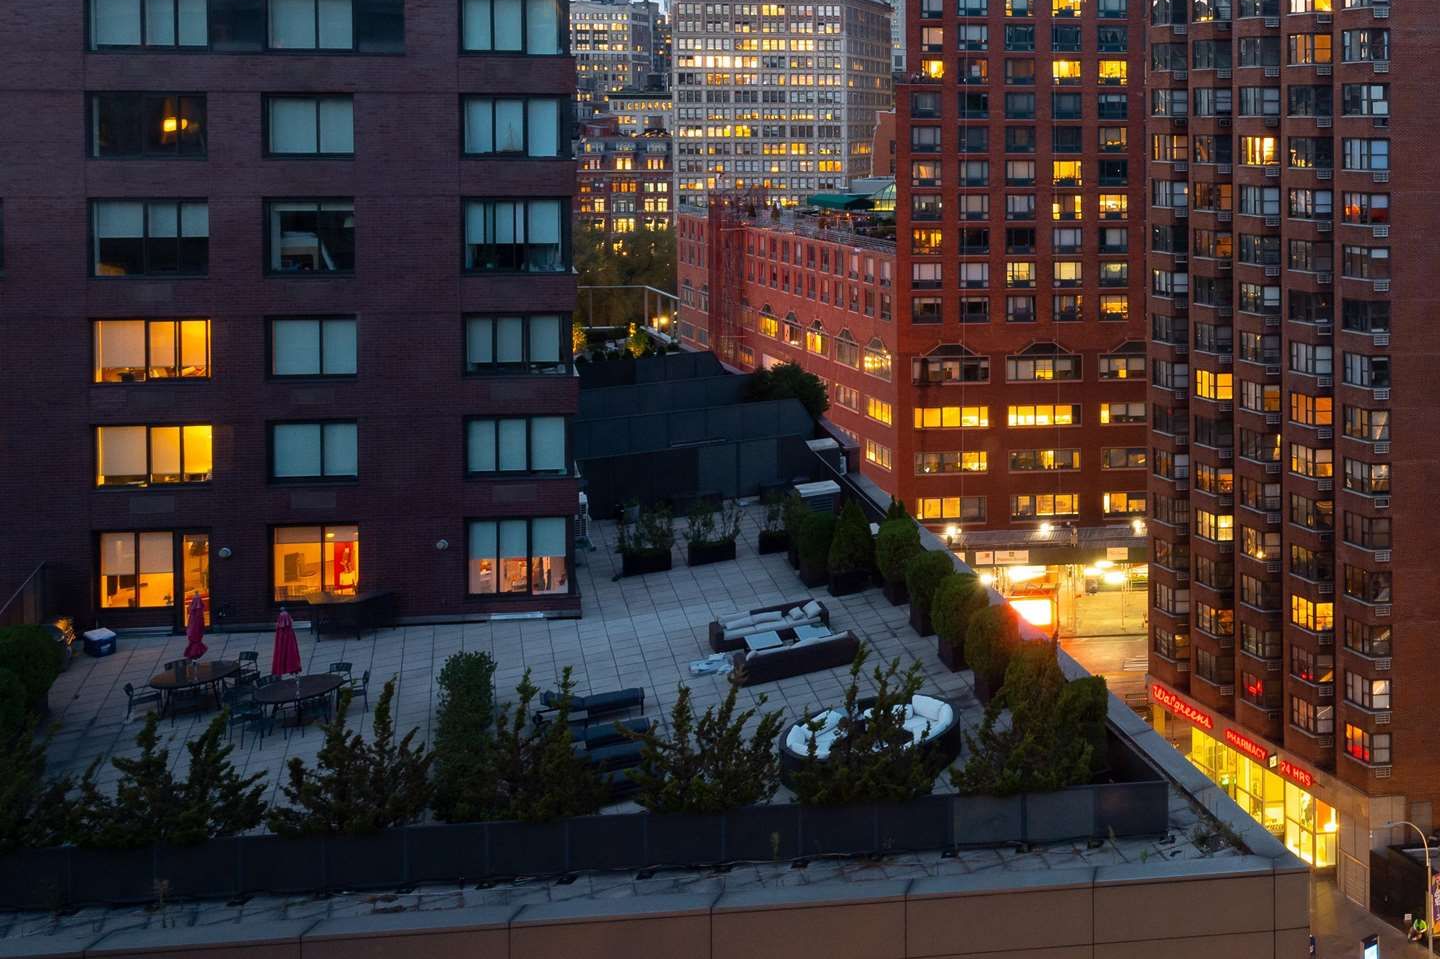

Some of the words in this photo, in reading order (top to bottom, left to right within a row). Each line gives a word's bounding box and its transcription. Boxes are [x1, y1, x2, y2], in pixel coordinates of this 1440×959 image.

[1152, 685, 1212, 729] Walgreens
[1225, 729, 1267, 760] PHARMACY
[1280, 761, 1291, 775] 24
[1292, 767, 1312, 788] HRS
